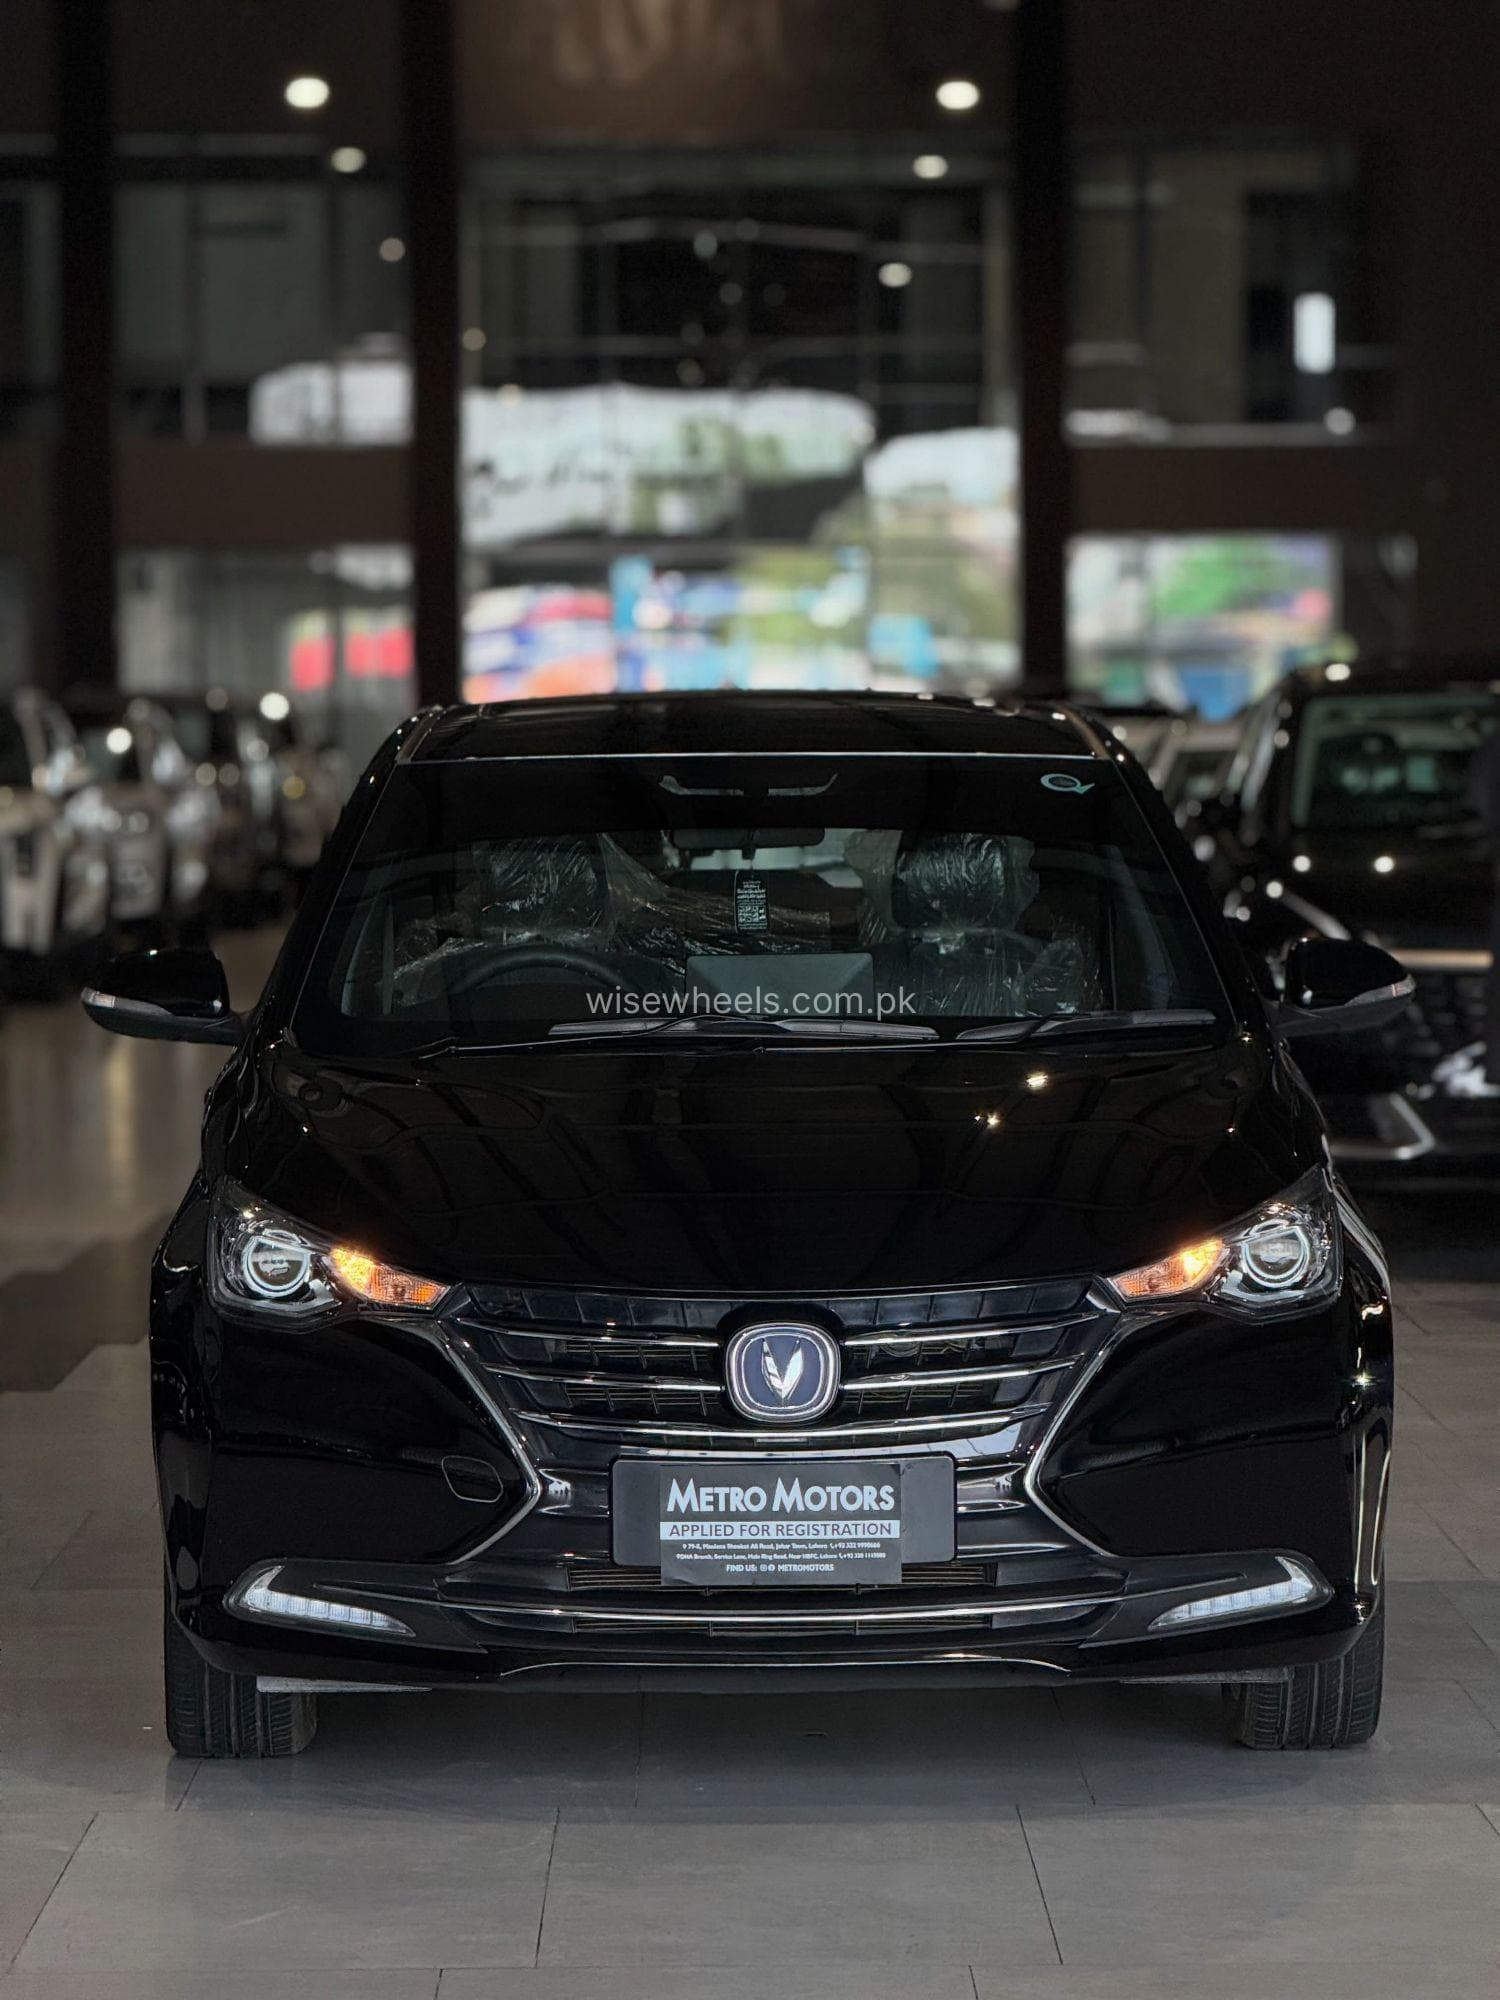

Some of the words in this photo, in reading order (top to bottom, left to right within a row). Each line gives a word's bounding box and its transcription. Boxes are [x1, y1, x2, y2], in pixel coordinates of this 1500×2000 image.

[666, 1477, 767, 1513] METRO
[772, 1476, 895, 1513] MOTORS
[669, 1524, 734, 1537] APPLIED
[740, 1523, 771, 1537] FOR
[776, 1522, 892, 1537] REGISTRATION
[726, 1564, 744, 1572] FIND
[745, 1564, 758, 1572] US:
[777, 1563, 835, 1572] METROMOTORS
